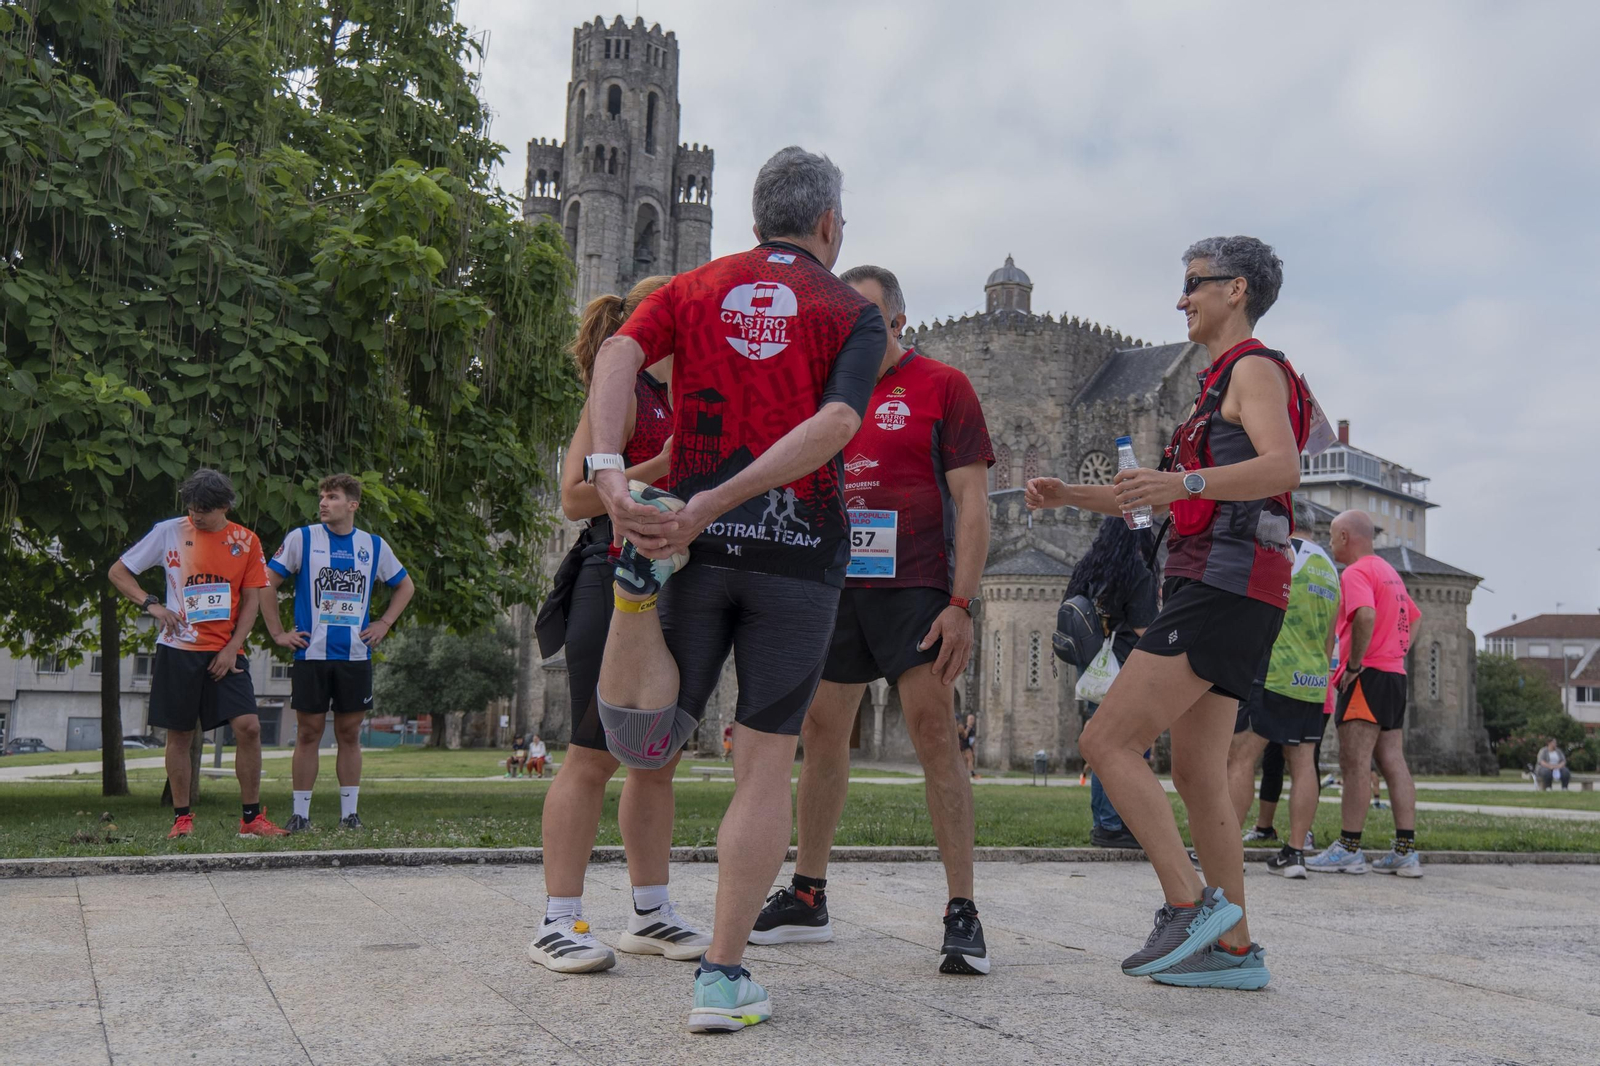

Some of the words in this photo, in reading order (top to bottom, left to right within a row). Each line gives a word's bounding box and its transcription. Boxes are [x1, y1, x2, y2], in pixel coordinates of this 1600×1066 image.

[720, 311, 787, 330] CASTRO
[739, 325, 791, 343] TRAIL
[772, 527, 821, 549] TEAM
[852, 531, 876, 547] 57
[207, 594, 222, 605] 87
[341, 602, 354, 611] 86
[1184, 905, 1212, 936] HOKA
